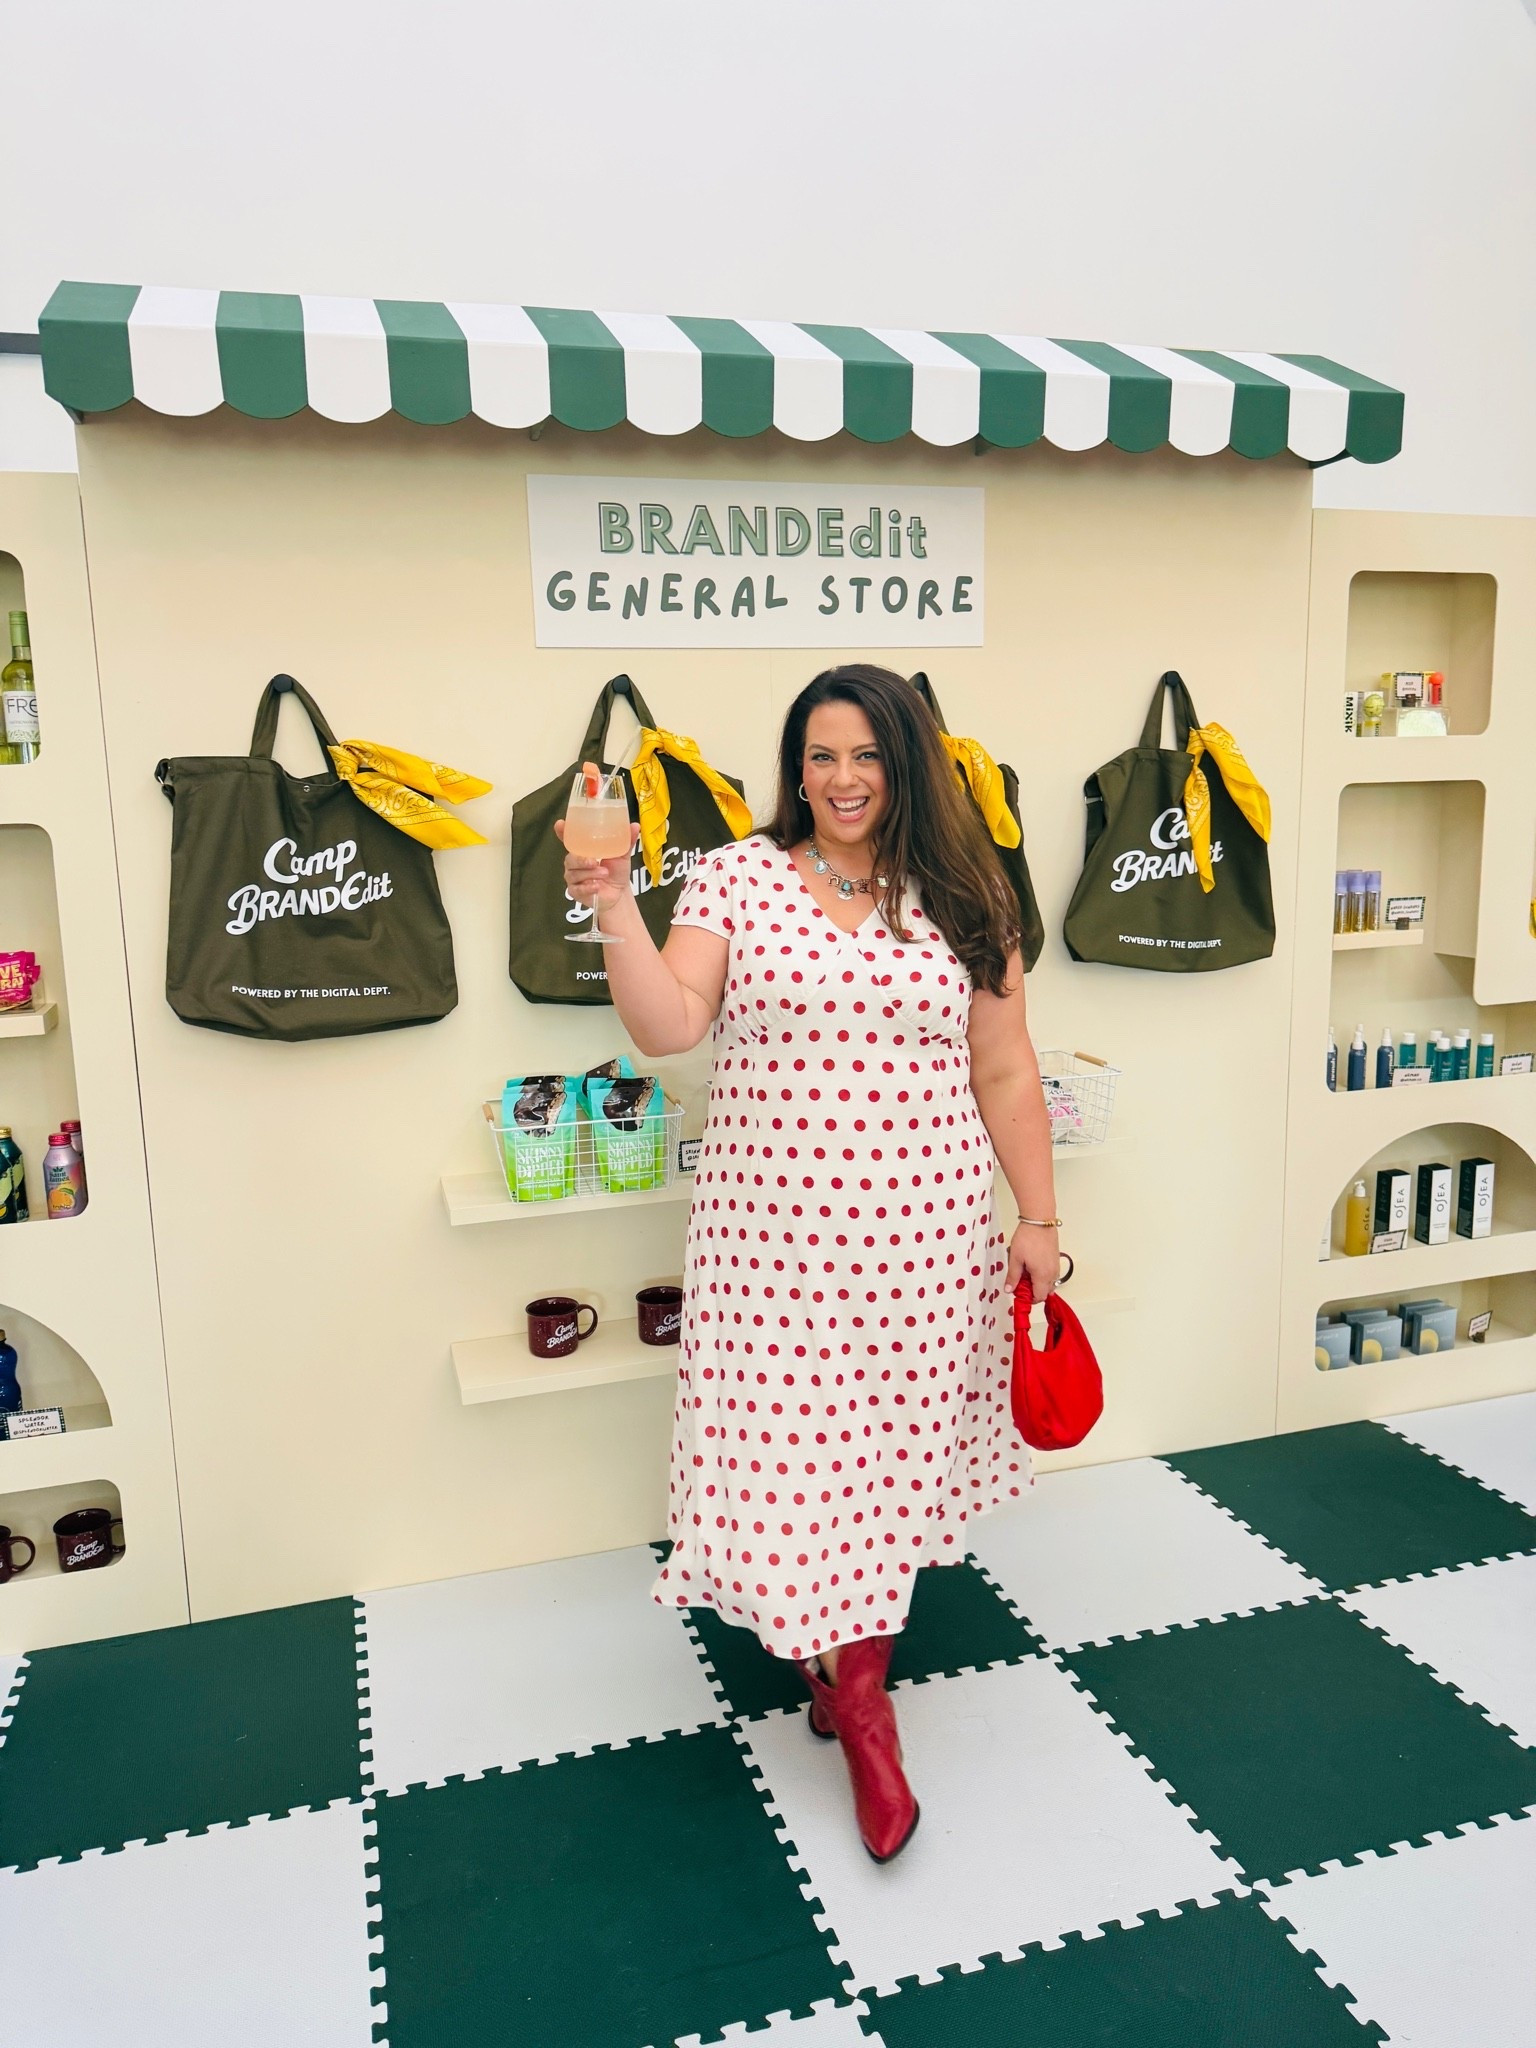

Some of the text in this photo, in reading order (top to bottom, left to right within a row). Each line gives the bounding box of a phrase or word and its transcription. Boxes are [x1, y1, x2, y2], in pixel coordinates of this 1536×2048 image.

[598, 502, 927, 558] BRANDEdit
[547, 571, 973, 619] GENERAL STORE
[1150, 807, 1191, 850] Ca
[263, 837, 357, 884] Camp
[225, 871, 394, 935] BRANDEdit
[1118, 934, 1155, 946] POWERED
[1156, 939, 1168, 947] BY
[1169, 940, 1186, 949] THE
[576, 971, 608, 980] POWER
[231, 985, 391, 998] POWERED BY THE DIGITAL DEPT.
[1394, 1188, 1407, 1219] OSEA
[1434, 1182, 1448, 1212] OSEA
[1478, 1176, 1491, 1206] OSEA
[555, 1321, 575, 1336] Camp
[74, 1540, 98, 1555] Camp
